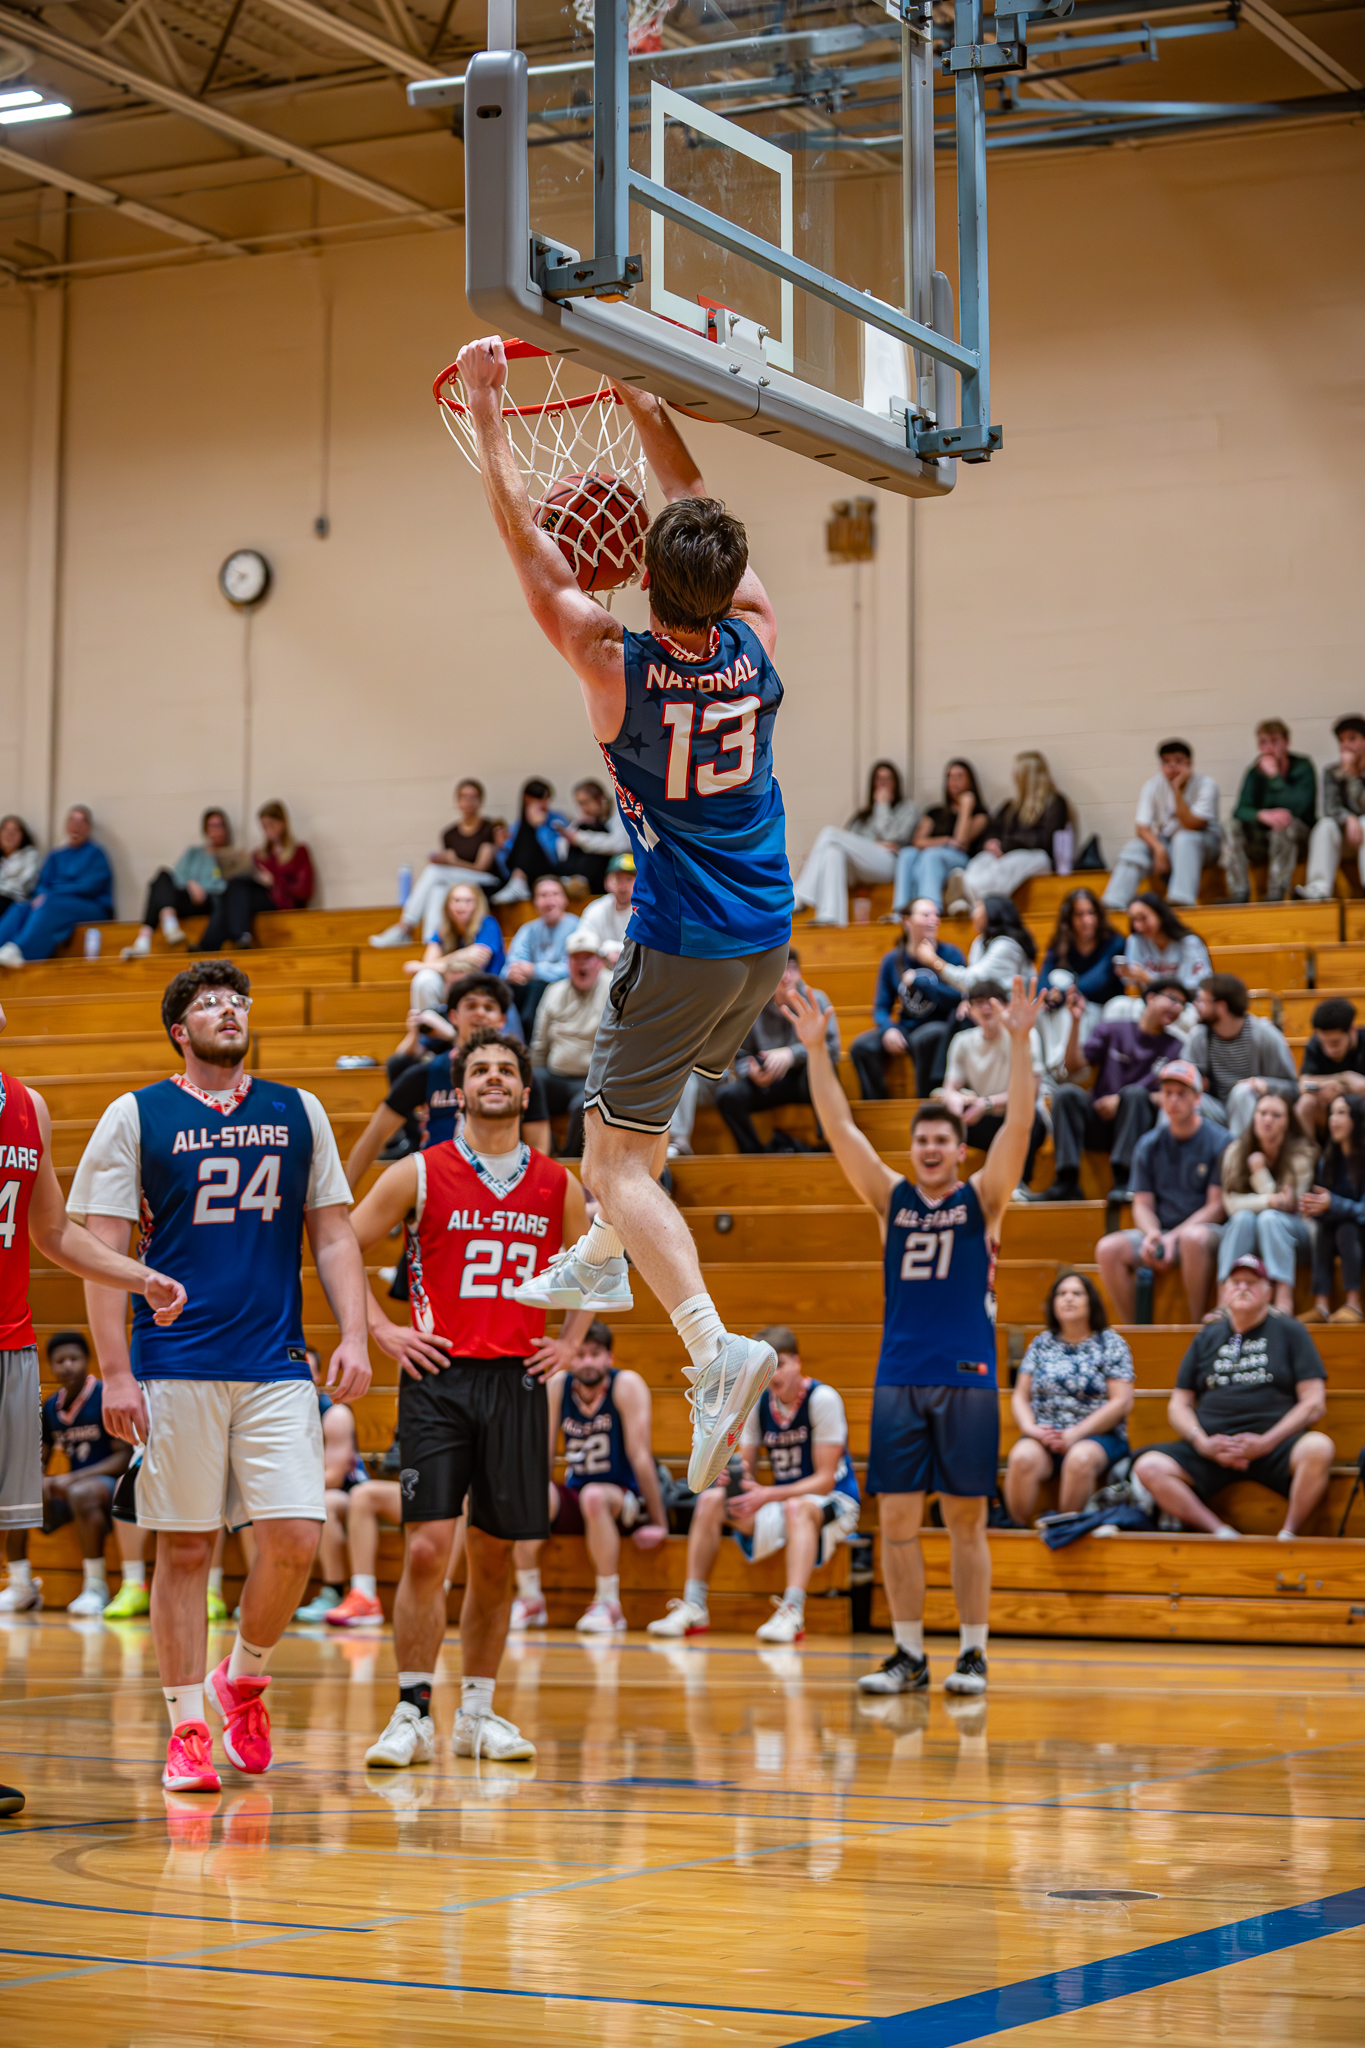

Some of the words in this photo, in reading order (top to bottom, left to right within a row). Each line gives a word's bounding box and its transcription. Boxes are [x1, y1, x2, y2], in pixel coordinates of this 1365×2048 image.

[661, 693, 762, 800] 13
[172, 1124, 289, 1154] ALL-STARS
[0, 1180, 21, 1249] 4
[192, 1154, 282, 1225] 24
[447, 1209, 550, 1237] ALL-STARS
[459, 1239, 537, 1299] 23
[901, 1229, 954, 1280] 21
